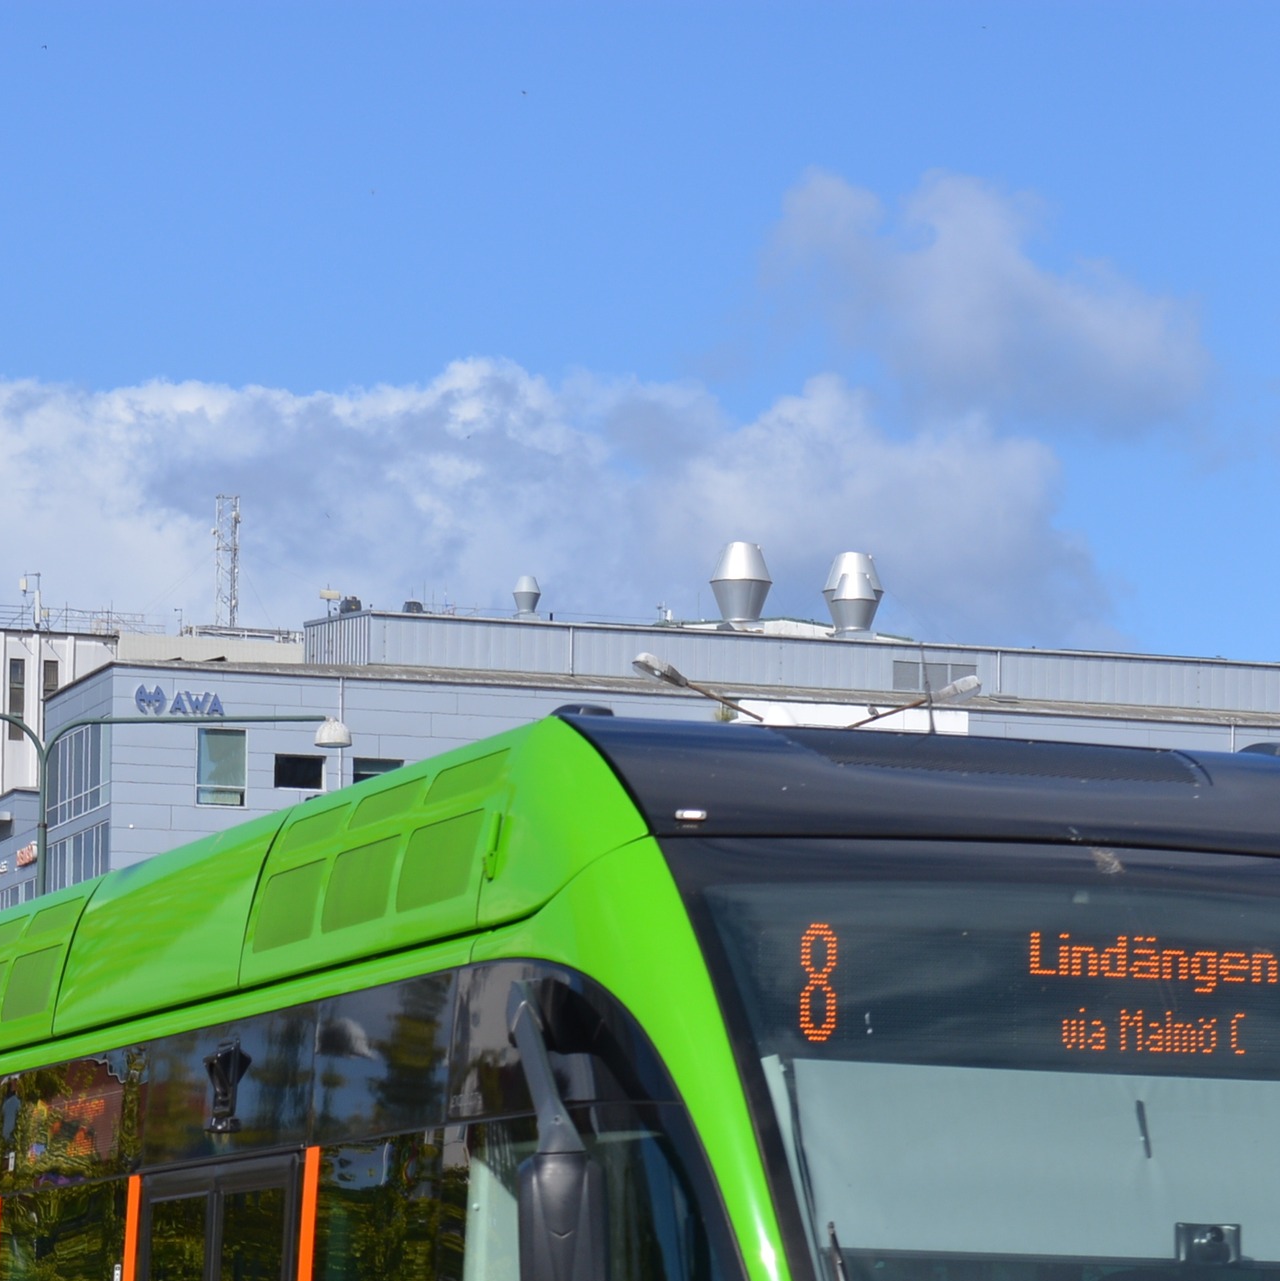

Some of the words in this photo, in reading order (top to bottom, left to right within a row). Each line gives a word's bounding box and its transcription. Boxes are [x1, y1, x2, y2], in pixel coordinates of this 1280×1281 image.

[169, 690, 225, 716] AWA
[800, 923, 837, 1041] 8
[1030, 932, 1278, 993] Lindängen
[1062, 1008, 1106, 1050] via
[1120, 1009, 1217, 1053] Malmö
[1231, 1013, 1246, 1055] C
